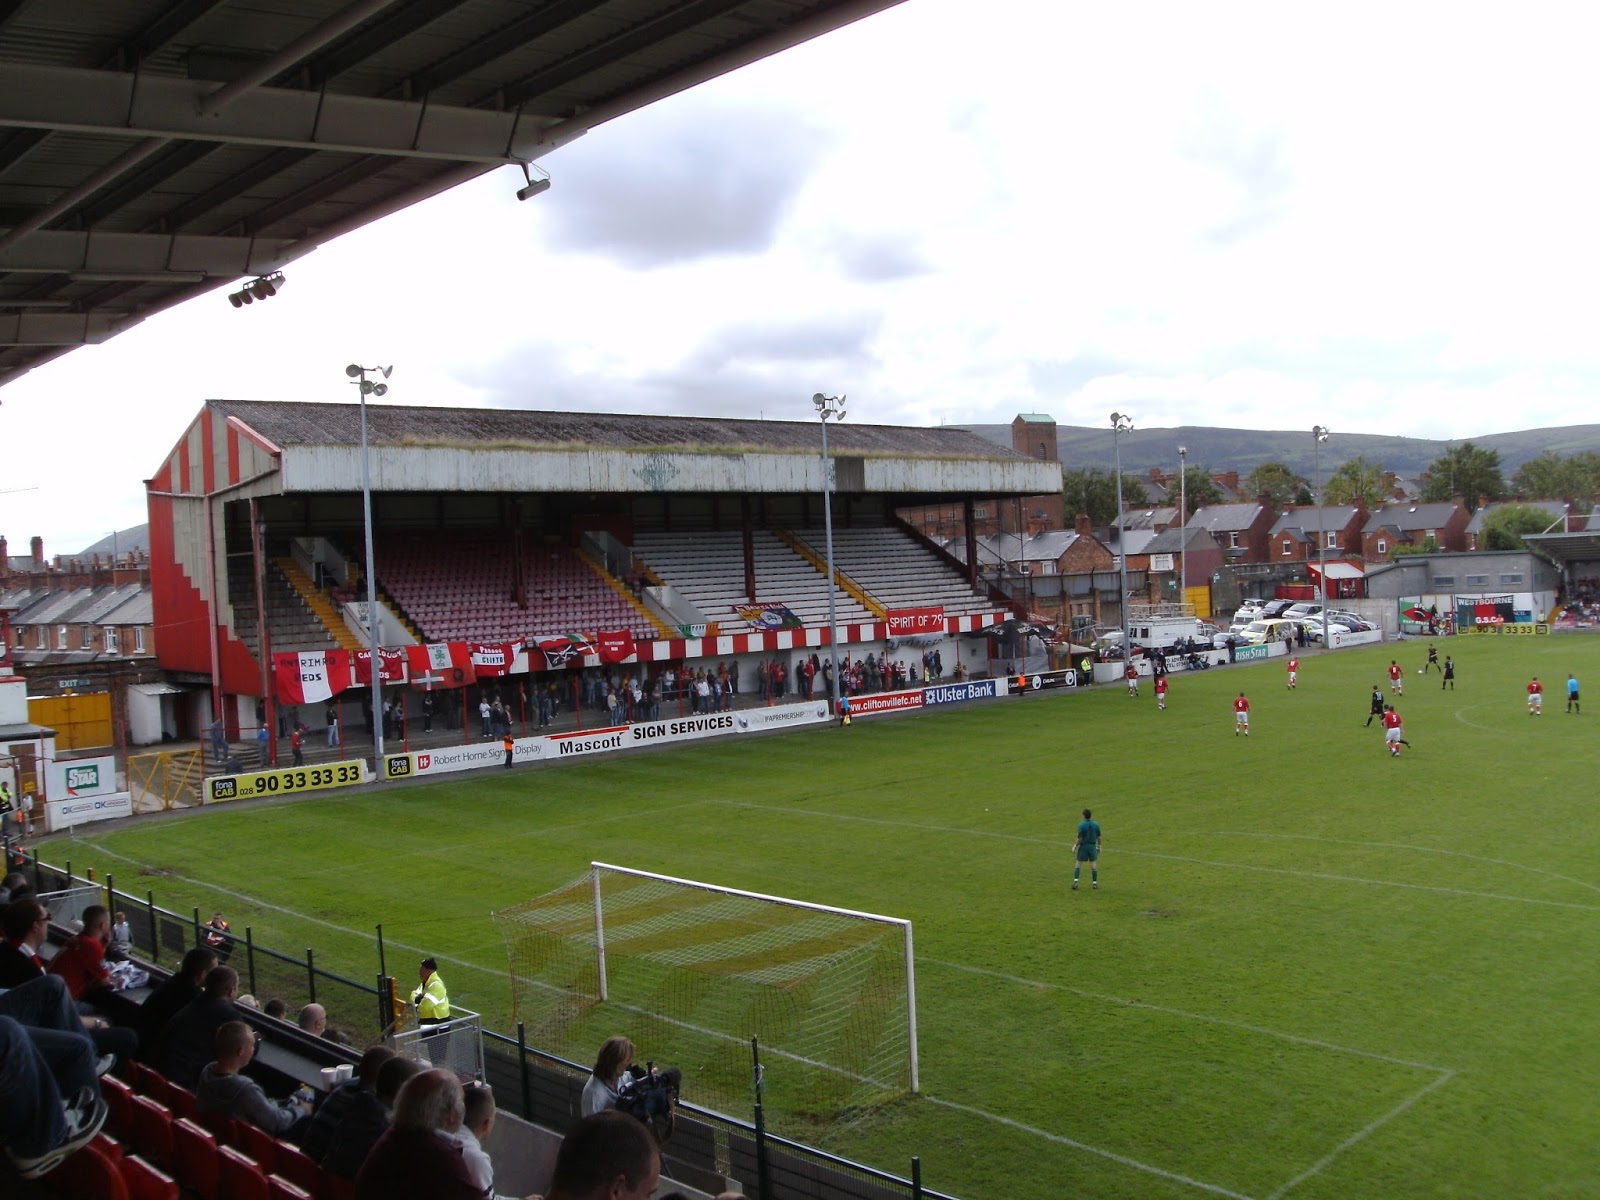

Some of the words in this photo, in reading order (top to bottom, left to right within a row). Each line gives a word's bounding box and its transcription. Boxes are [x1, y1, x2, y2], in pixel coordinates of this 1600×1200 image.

[1457, 597, 1513, 606] WESTBOURNE
[889, 616, 915, 628] SPIRIT
[917, 615, 928, 627] OF
[932, 613, 943, 626] 79
[1235, 651, 1250, 660] RISH
[59, 679, 78, 688] EXIT
[936, 687, 966, 703] Ulster
[968, 682, 993, 698] Bank
[849, 694, 923, 712] ww.cliftonvillefc.net
[1392, 714, 1397, 722] 5
[559, 736, 622, 755] Mascott
[633, 725, 666, 740] SIGN
[670, 716, 733, 735] SERVICES
[434, 754, 461, 765] Robert
[463, 751, 487, 761] Horne
[488, 749, 506, 761] Sign
[515, 745, 542, 756] Display
[391, 759, 407, 767] fona
[391, 766, 408, 774] CAB
[68, 769, 97, 788] STAR
[239, 787, 254, 796] 028
[255, 775, 279, 794] 90
[283, 772, 306, 790] 33
[311, 769, 333, 786] 33
[338, 766, 360, 783] 33
[215, 781, 233, 790] fona
[215, 788, 234, 797] CAB
